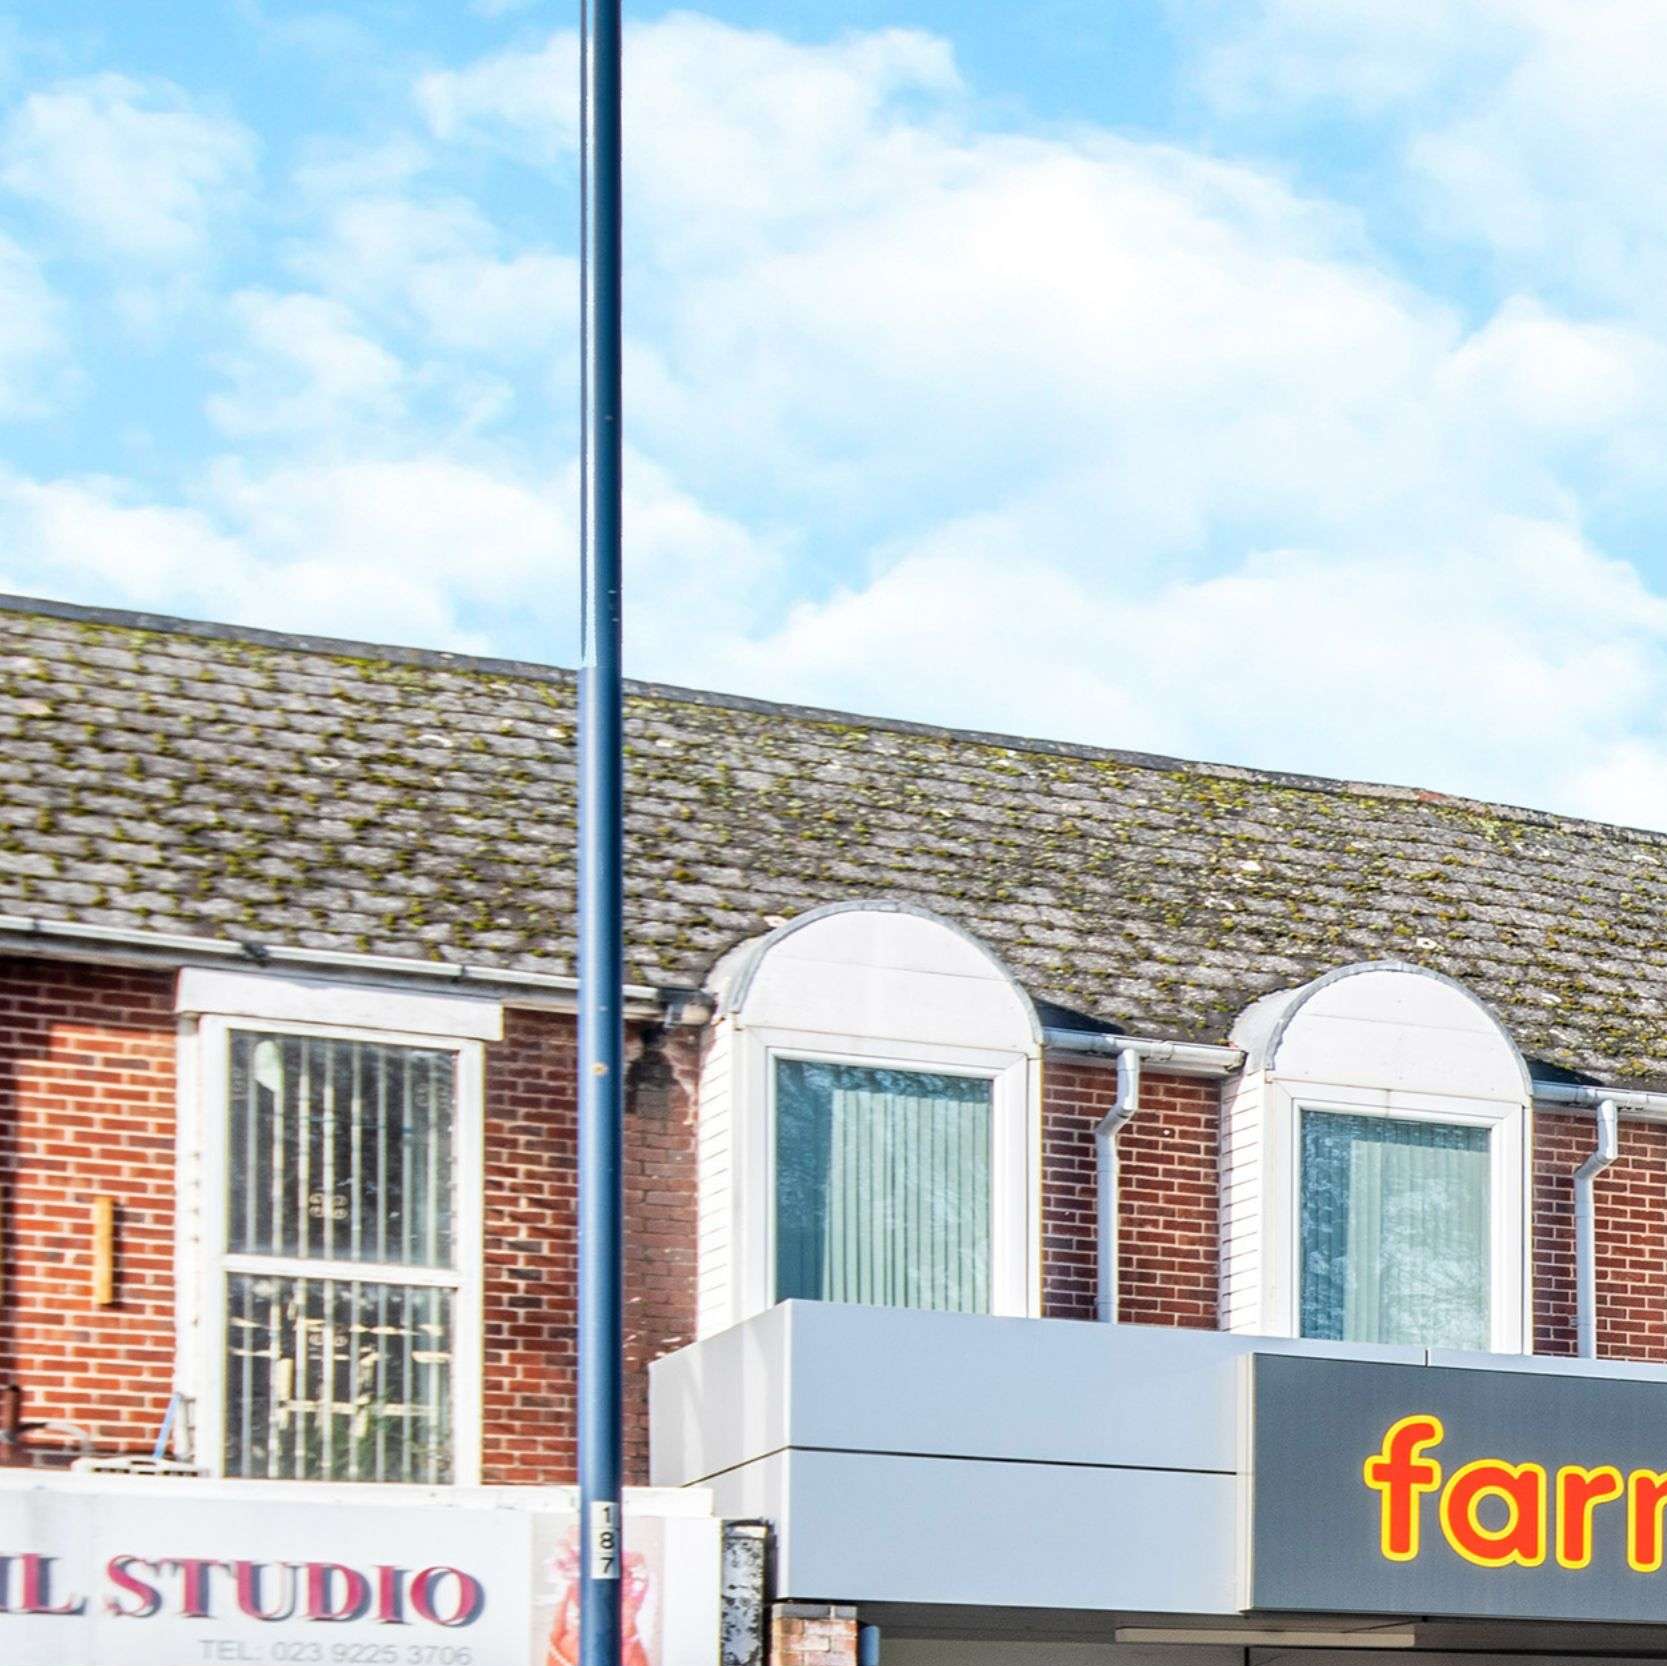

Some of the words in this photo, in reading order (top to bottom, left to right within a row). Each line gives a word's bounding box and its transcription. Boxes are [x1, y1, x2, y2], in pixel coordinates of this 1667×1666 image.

[105, 1554, 486, 1628] STUDIO
[199, 1639, 260, 1662] TEL:
[270, 1641, 324, 1663] 023
[331, 1643, 397, 1664] 9225
[407, 1644, 473, 1666] 3706
